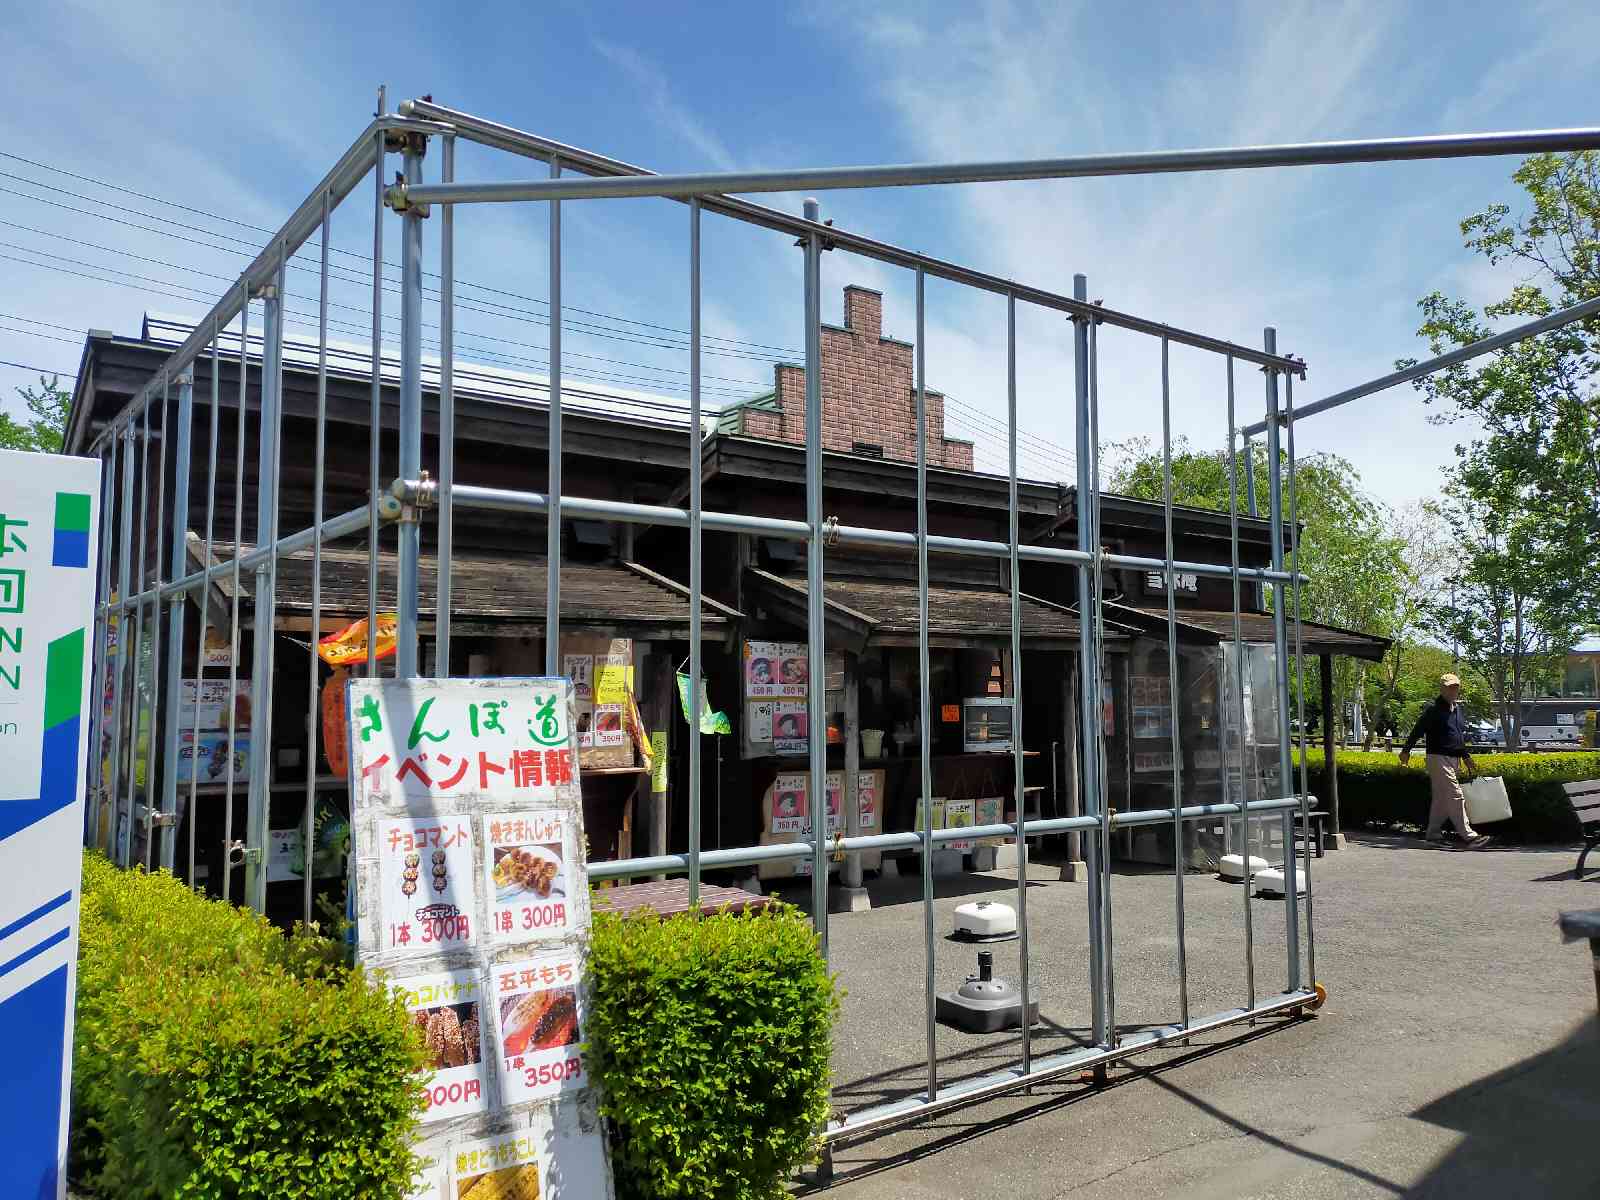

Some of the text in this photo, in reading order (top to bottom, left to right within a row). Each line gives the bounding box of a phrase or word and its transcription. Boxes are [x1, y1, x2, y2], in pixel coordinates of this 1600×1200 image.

[360, 694, 568, 750] さんぽ道
[362, 749, 574, 791] イベント情報
[388, 823, 468, 851] チョコマント
[490, 817, 561, 845] 焼きまんじゅう
[521, 903, 567, 931] 300円
[397, 978, 481, 1006] ョコバナナ
[500, 962, 574, 993] 五平もち
[524, 1055, 582, 1088] 350円
